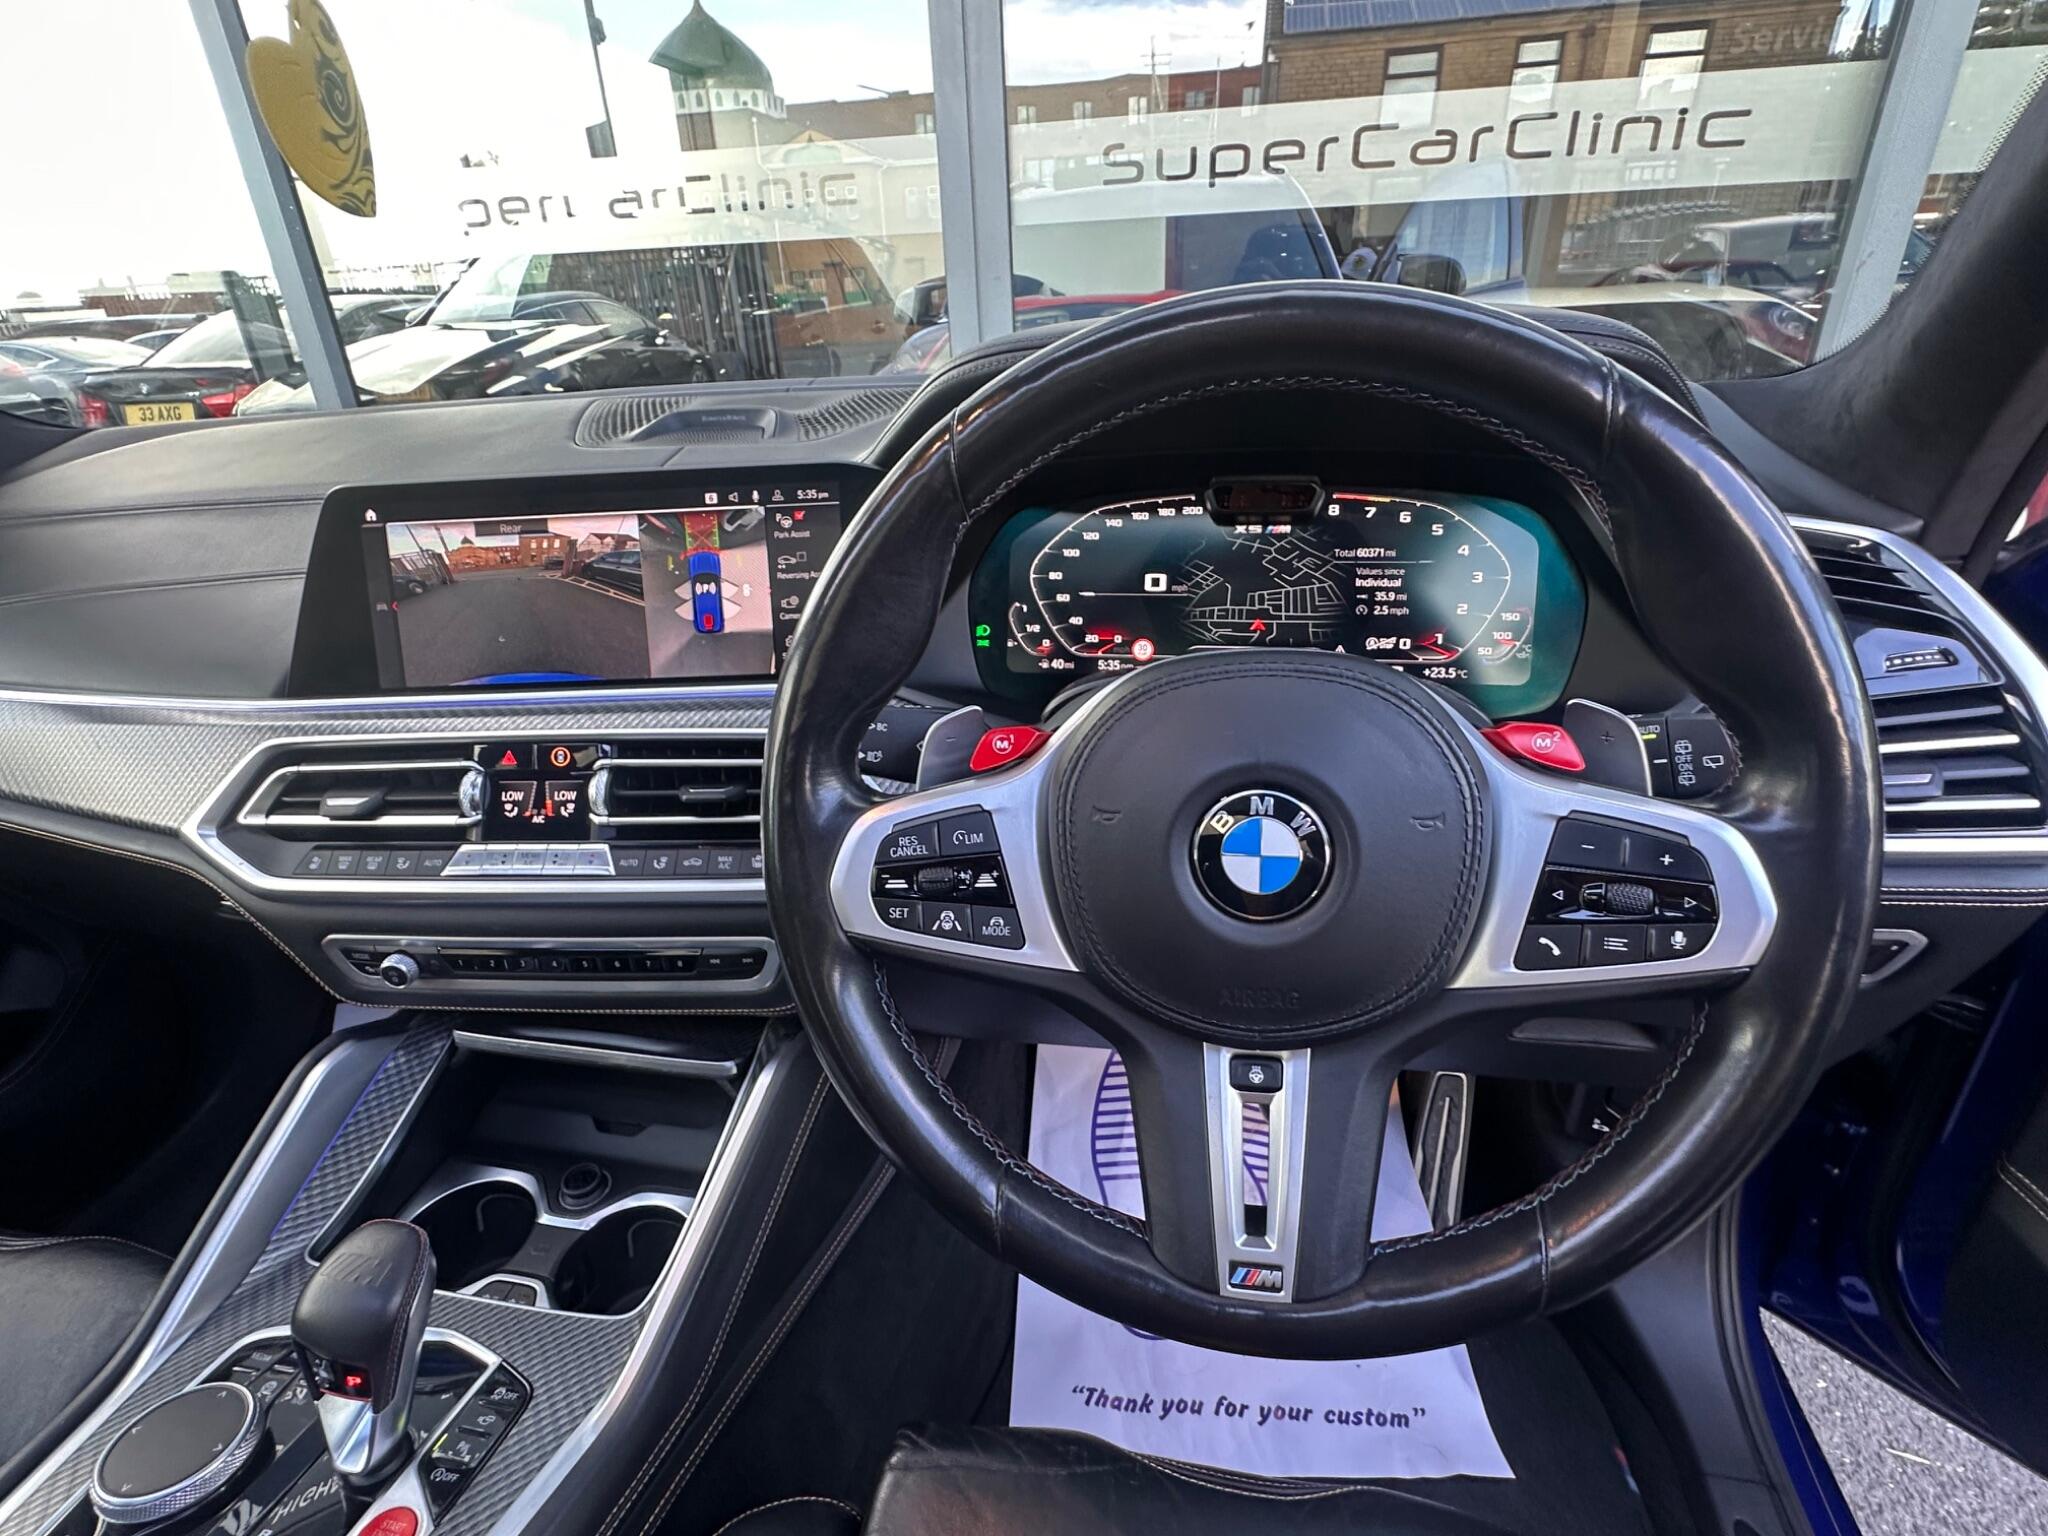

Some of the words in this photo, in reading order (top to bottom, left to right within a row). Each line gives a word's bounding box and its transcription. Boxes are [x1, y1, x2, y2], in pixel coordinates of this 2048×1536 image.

[1102, 107, 1752, 188] SuperCarClinic
[138, 406, 154, 422] 33
[158, 405, 182, 421] AXG
[797, 489, 817, 500] 5:35
[1157, 508, 1175, 516] 180
[1182, 506, 1203, 515] 200
[1328, 504, 1340, 516] 8
[1364, 507, 1377, 518] 7
[1131, 512, 1149, 520] 160
[1399, 512, 1411, 523] 6
[1105, 519, 1123, 527] 140
[500, 524, 522, 533] Rear
[1432, 524, 1444, 535] 5
[1082, 532, 1099, 540] 120
[1062, 549, 1080, 557] 100
[1335, 549, 1355, 557] Total
[1357, 549, 1385, 557] 60371
[1385, 549, 1396, 557] mi
[1457, 545, 1470, 556] 4
[1049, 572, 1063, 580] 80
[1356, 568, 1382, 576] Values
[1384, 568, 1405, 576] since
[1472, 572, 1483, 583] 3
[1144, 573, 1167, 592] 0
[1355, 578, 1401, 587] Individual
[1056, 594, 1070, 602] 60
[1374, 592, 1394, 601] 35.9
[1396, 593, 1407, 601] mi
[1022, 604, 1027, 612] 1
[1373, 606, 1388, 615] 2.5
[1390, 607, 1410, 615] mph
[1457, 604, 1468, 614] 2
[1068, 617, 1083, 625] 40
[1501, 613, 1520, 621] 150
[1025, 624, 1040, 632] 1/2
[1085, 635, 1099, 643] 20
[1114, 635, 1122, 643] 0
[1434, 633, 1443, 644] 1
[1492, 631, 1512, 639] 100
[1042, 639, 1050, 647] 0
[1477, 647, 1492, 655] 50
[1051, 659, 1064, 669] 40
[1098, 660, 1120, 670] 5:35
[502, 791, 524, 801] LOW
[554, 791, 577, 800] LOW
[531, 815, 546, 824] A/C
[1210, 796, 1316, 836] BMW
[898, 835, 918, 846] RES
[965, 833, 984, 844] LIM
[890, 845, 928, 857] CANCEL
[889, 908, 909, 919] SET
[982, 926, 1010, 937] MODE
[503, 1391, 520, 1400] OFF
[1160, 1398, 1204, 1420] you
[1213, 1396, 1249, 1418] for
[1257, 1405, 1313, 1427] your
[444, 1472, 460, 1482] OFF
[380, 1519, 407, 1531] START
